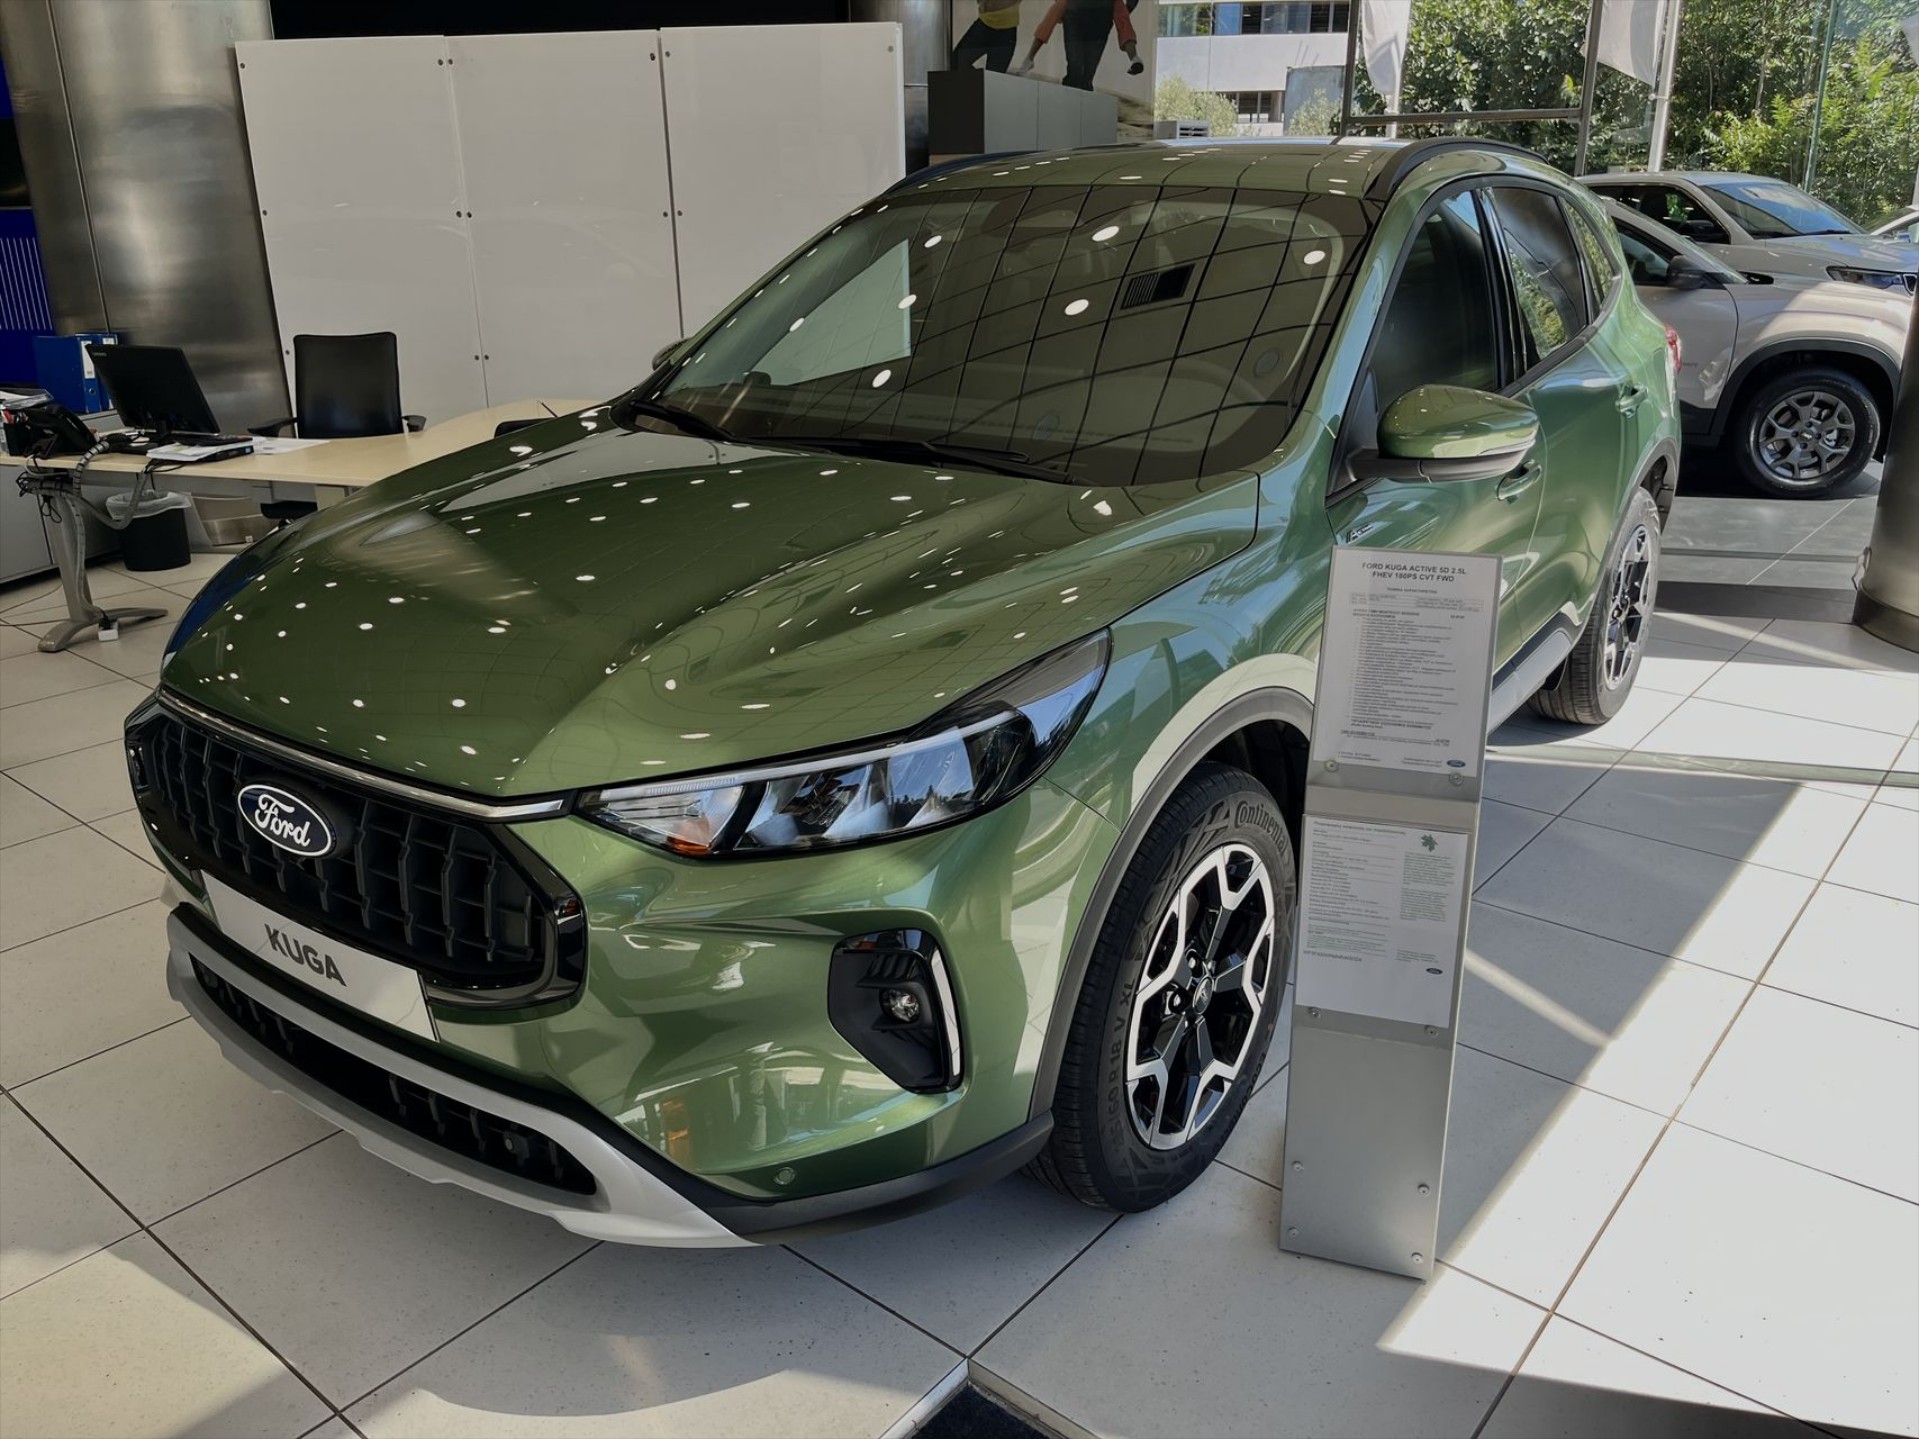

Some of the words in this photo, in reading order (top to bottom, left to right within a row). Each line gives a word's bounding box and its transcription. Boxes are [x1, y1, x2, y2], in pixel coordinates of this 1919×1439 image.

[1361, 562, 1383, 570] FORD
[1385, 563, 1407, 571] KUGA
[1409, 565, 1438, 573] ACTIVE
[1451, 567, 1466, 575] 2.5L
[1372, 571, 1392, 579] FHEV
[1419, 573, 1434, 581] CVT
[1437, 574, 1455, 582] FWD
[255, 794, 311, 847] Ford
[1234, 801, 1289, 857] Continental
[264, 923, 347, 987] KUGA
[1119, 979, 1136, 1006] XL
